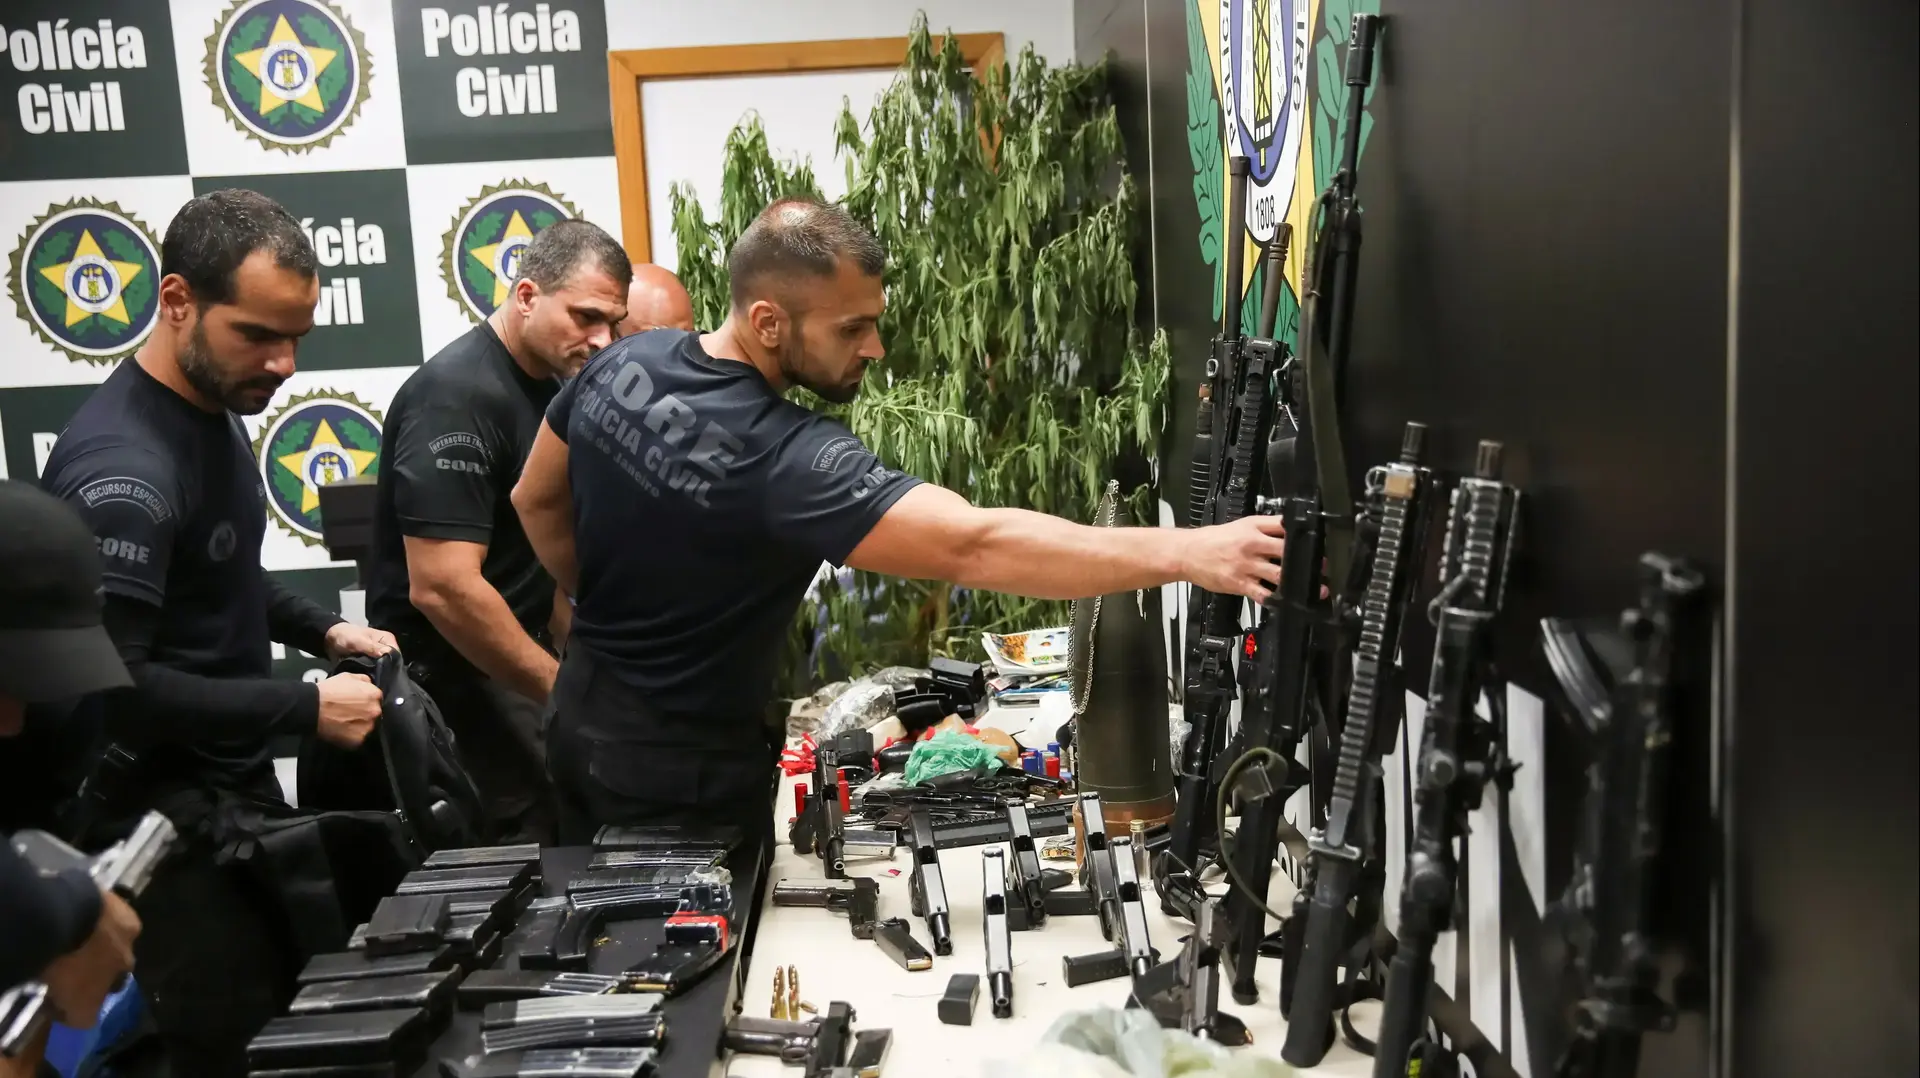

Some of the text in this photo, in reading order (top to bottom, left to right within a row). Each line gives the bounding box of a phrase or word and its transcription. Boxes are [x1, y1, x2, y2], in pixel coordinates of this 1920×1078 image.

[0, 18, 148, 72] olícia
[420, 3, 582, 57] Polícia
[17, 81, 126, 135] Civil
[455, 64, 558, 117] Civil
[1255, 195, 1275, 231] 1808
[313, 277, 365, 326] vil
[86, 483, 132, 502] RECURSOS
[436, 459, 483, 475] COR
[613, 452, 660, 497] Janeiro
[644, 445, 713, 508] CIVIL
